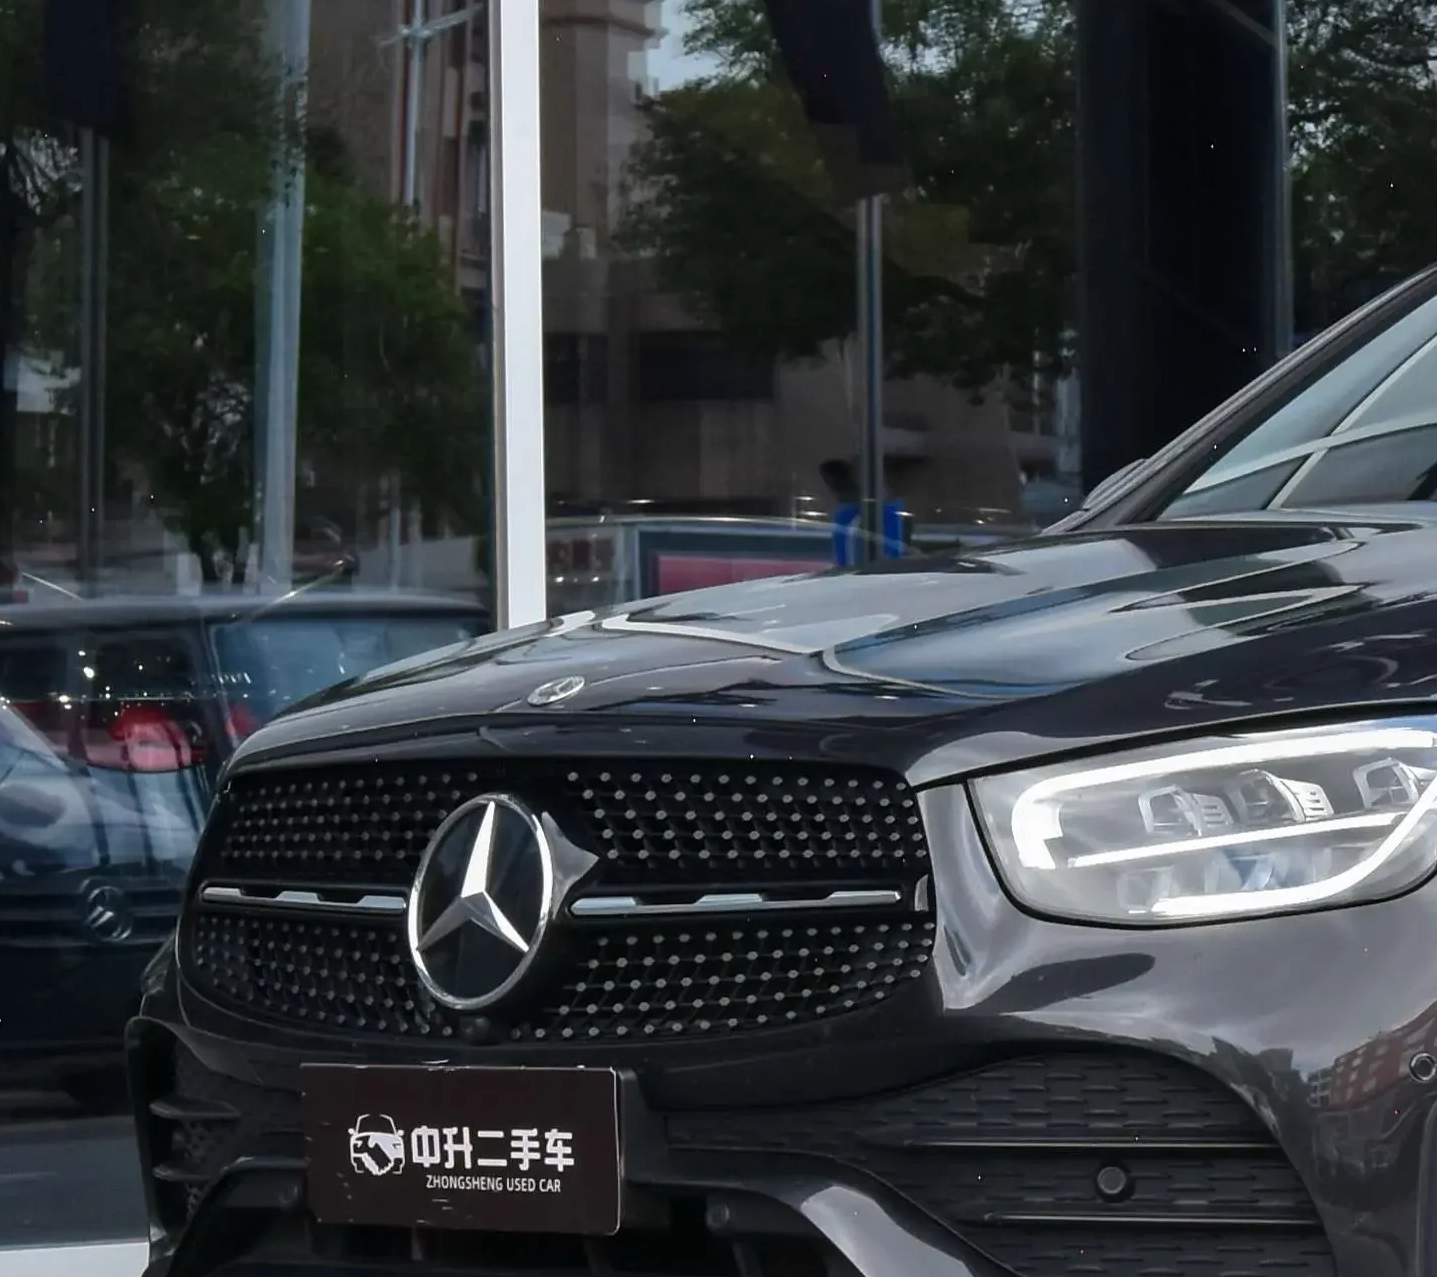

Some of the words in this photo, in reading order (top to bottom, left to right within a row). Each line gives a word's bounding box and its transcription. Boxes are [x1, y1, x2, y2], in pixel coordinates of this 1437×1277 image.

[411, 1125, 575, 1173] 中升二手车
[425, 1174, 504, 1192] ZHONGSHENG
[506, 1177, 536, 1193] USED
[538, 1178, 562, 1193] CAR
